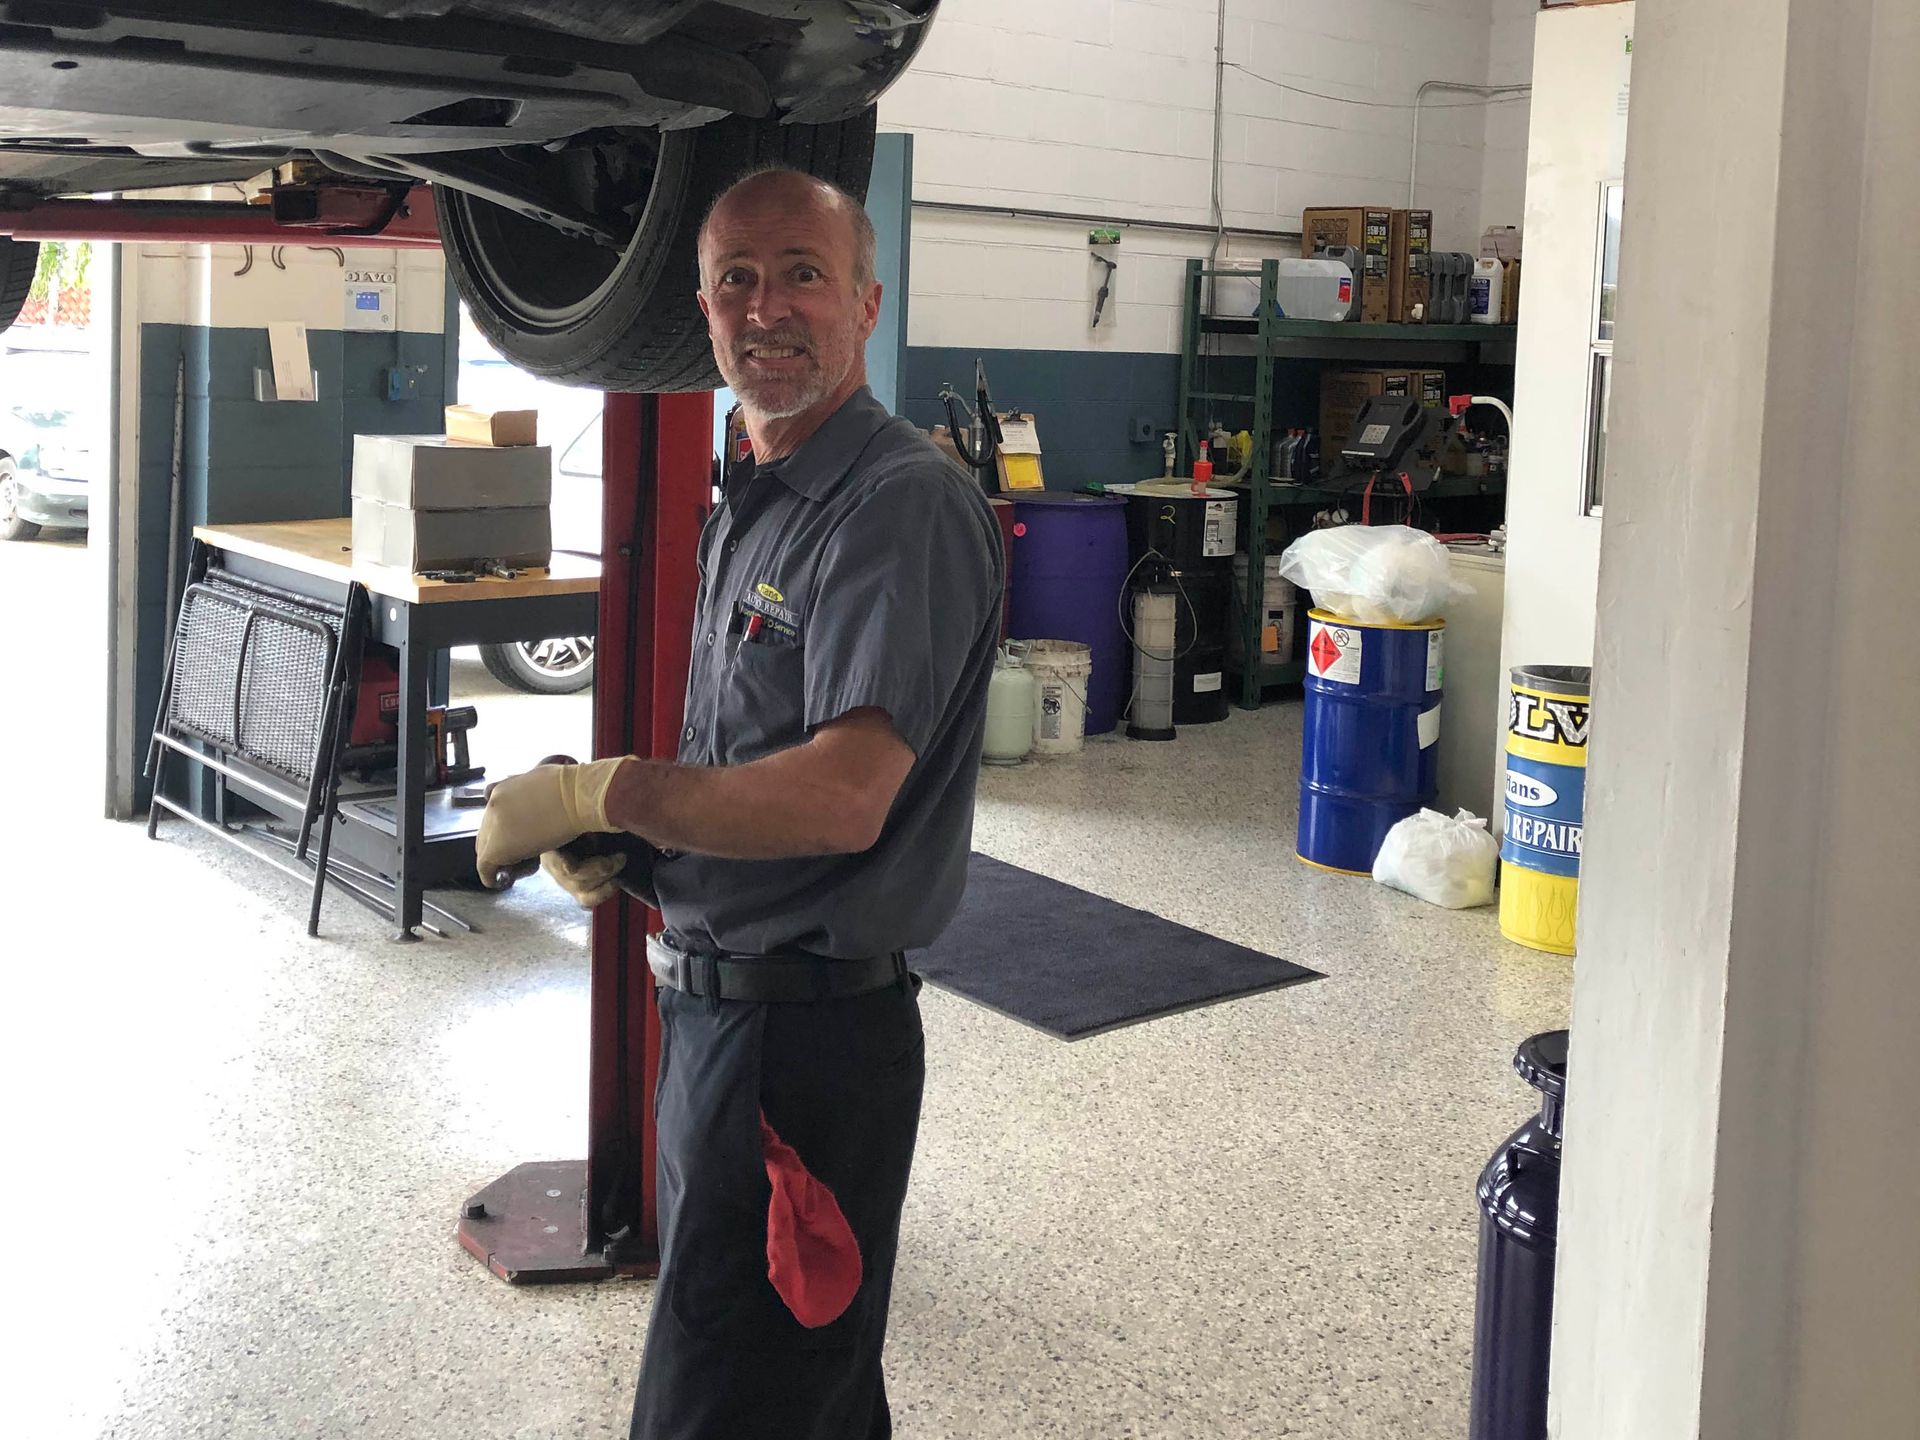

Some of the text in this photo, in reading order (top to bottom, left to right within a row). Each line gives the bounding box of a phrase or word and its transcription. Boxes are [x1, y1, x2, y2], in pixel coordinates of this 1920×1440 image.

[1160, 504, 1176, 525] 2
[763, 603, 793, 623] REPAIR
[1511, 813, 1583, 853] REPAIR
